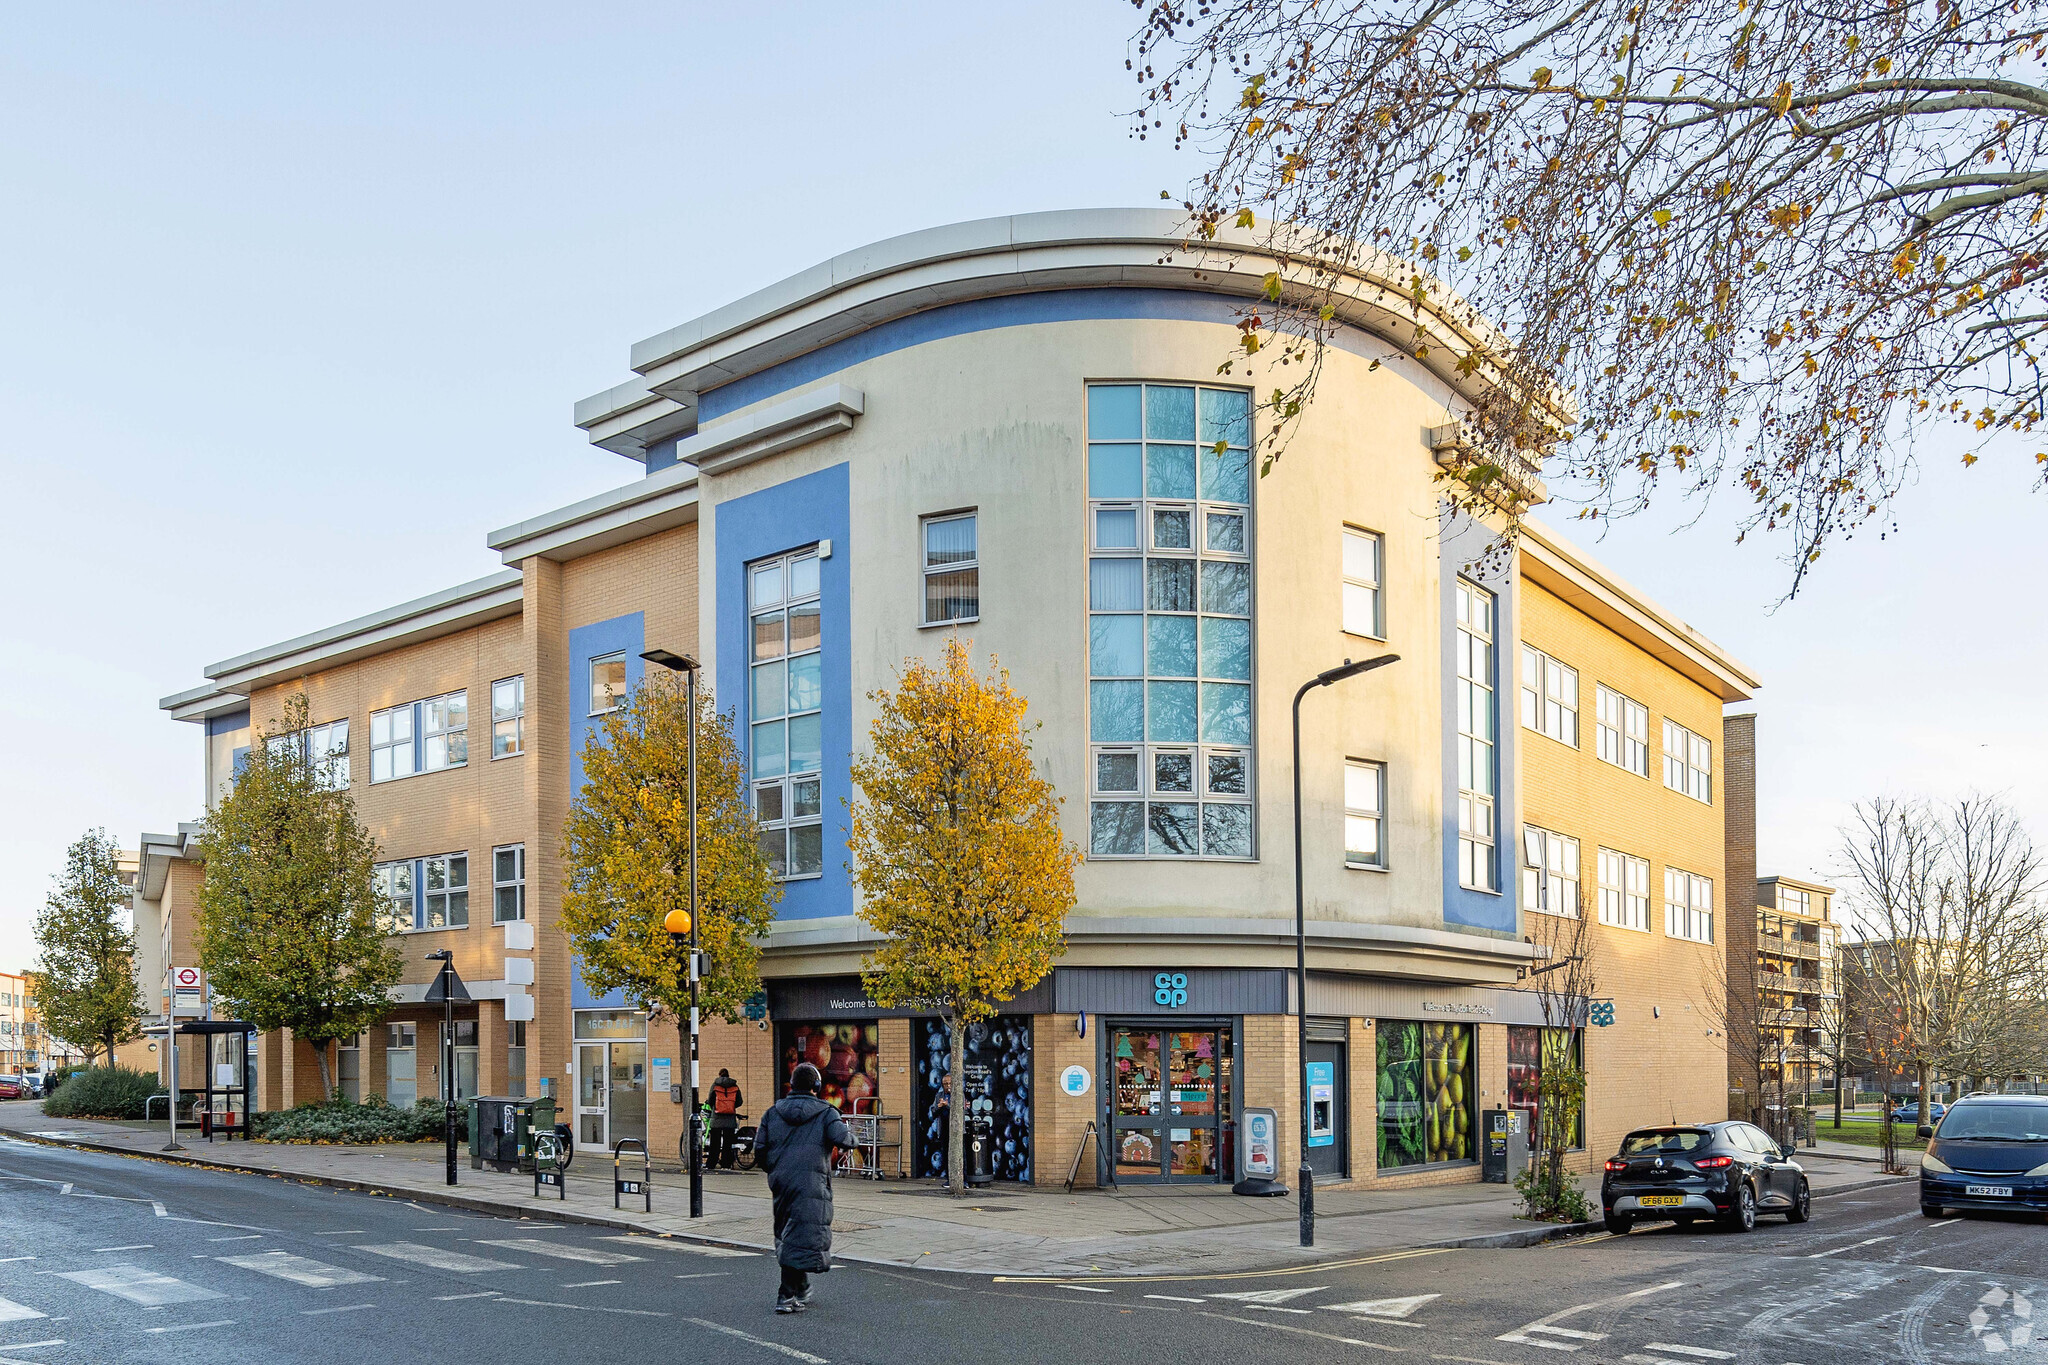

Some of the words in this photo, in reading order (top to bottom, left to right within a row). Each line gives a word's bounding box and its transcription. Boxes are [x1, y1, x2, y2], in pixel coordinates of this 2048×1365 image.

[830, 999, 865, 1009] Welcome
[868, 1000, 876, 1008] to
[1969, 1186, 1991, 1195] MK52
[1992, 1187, 2009, 1195] FBY
[1663, 1196, 1680, 1204] GXX
